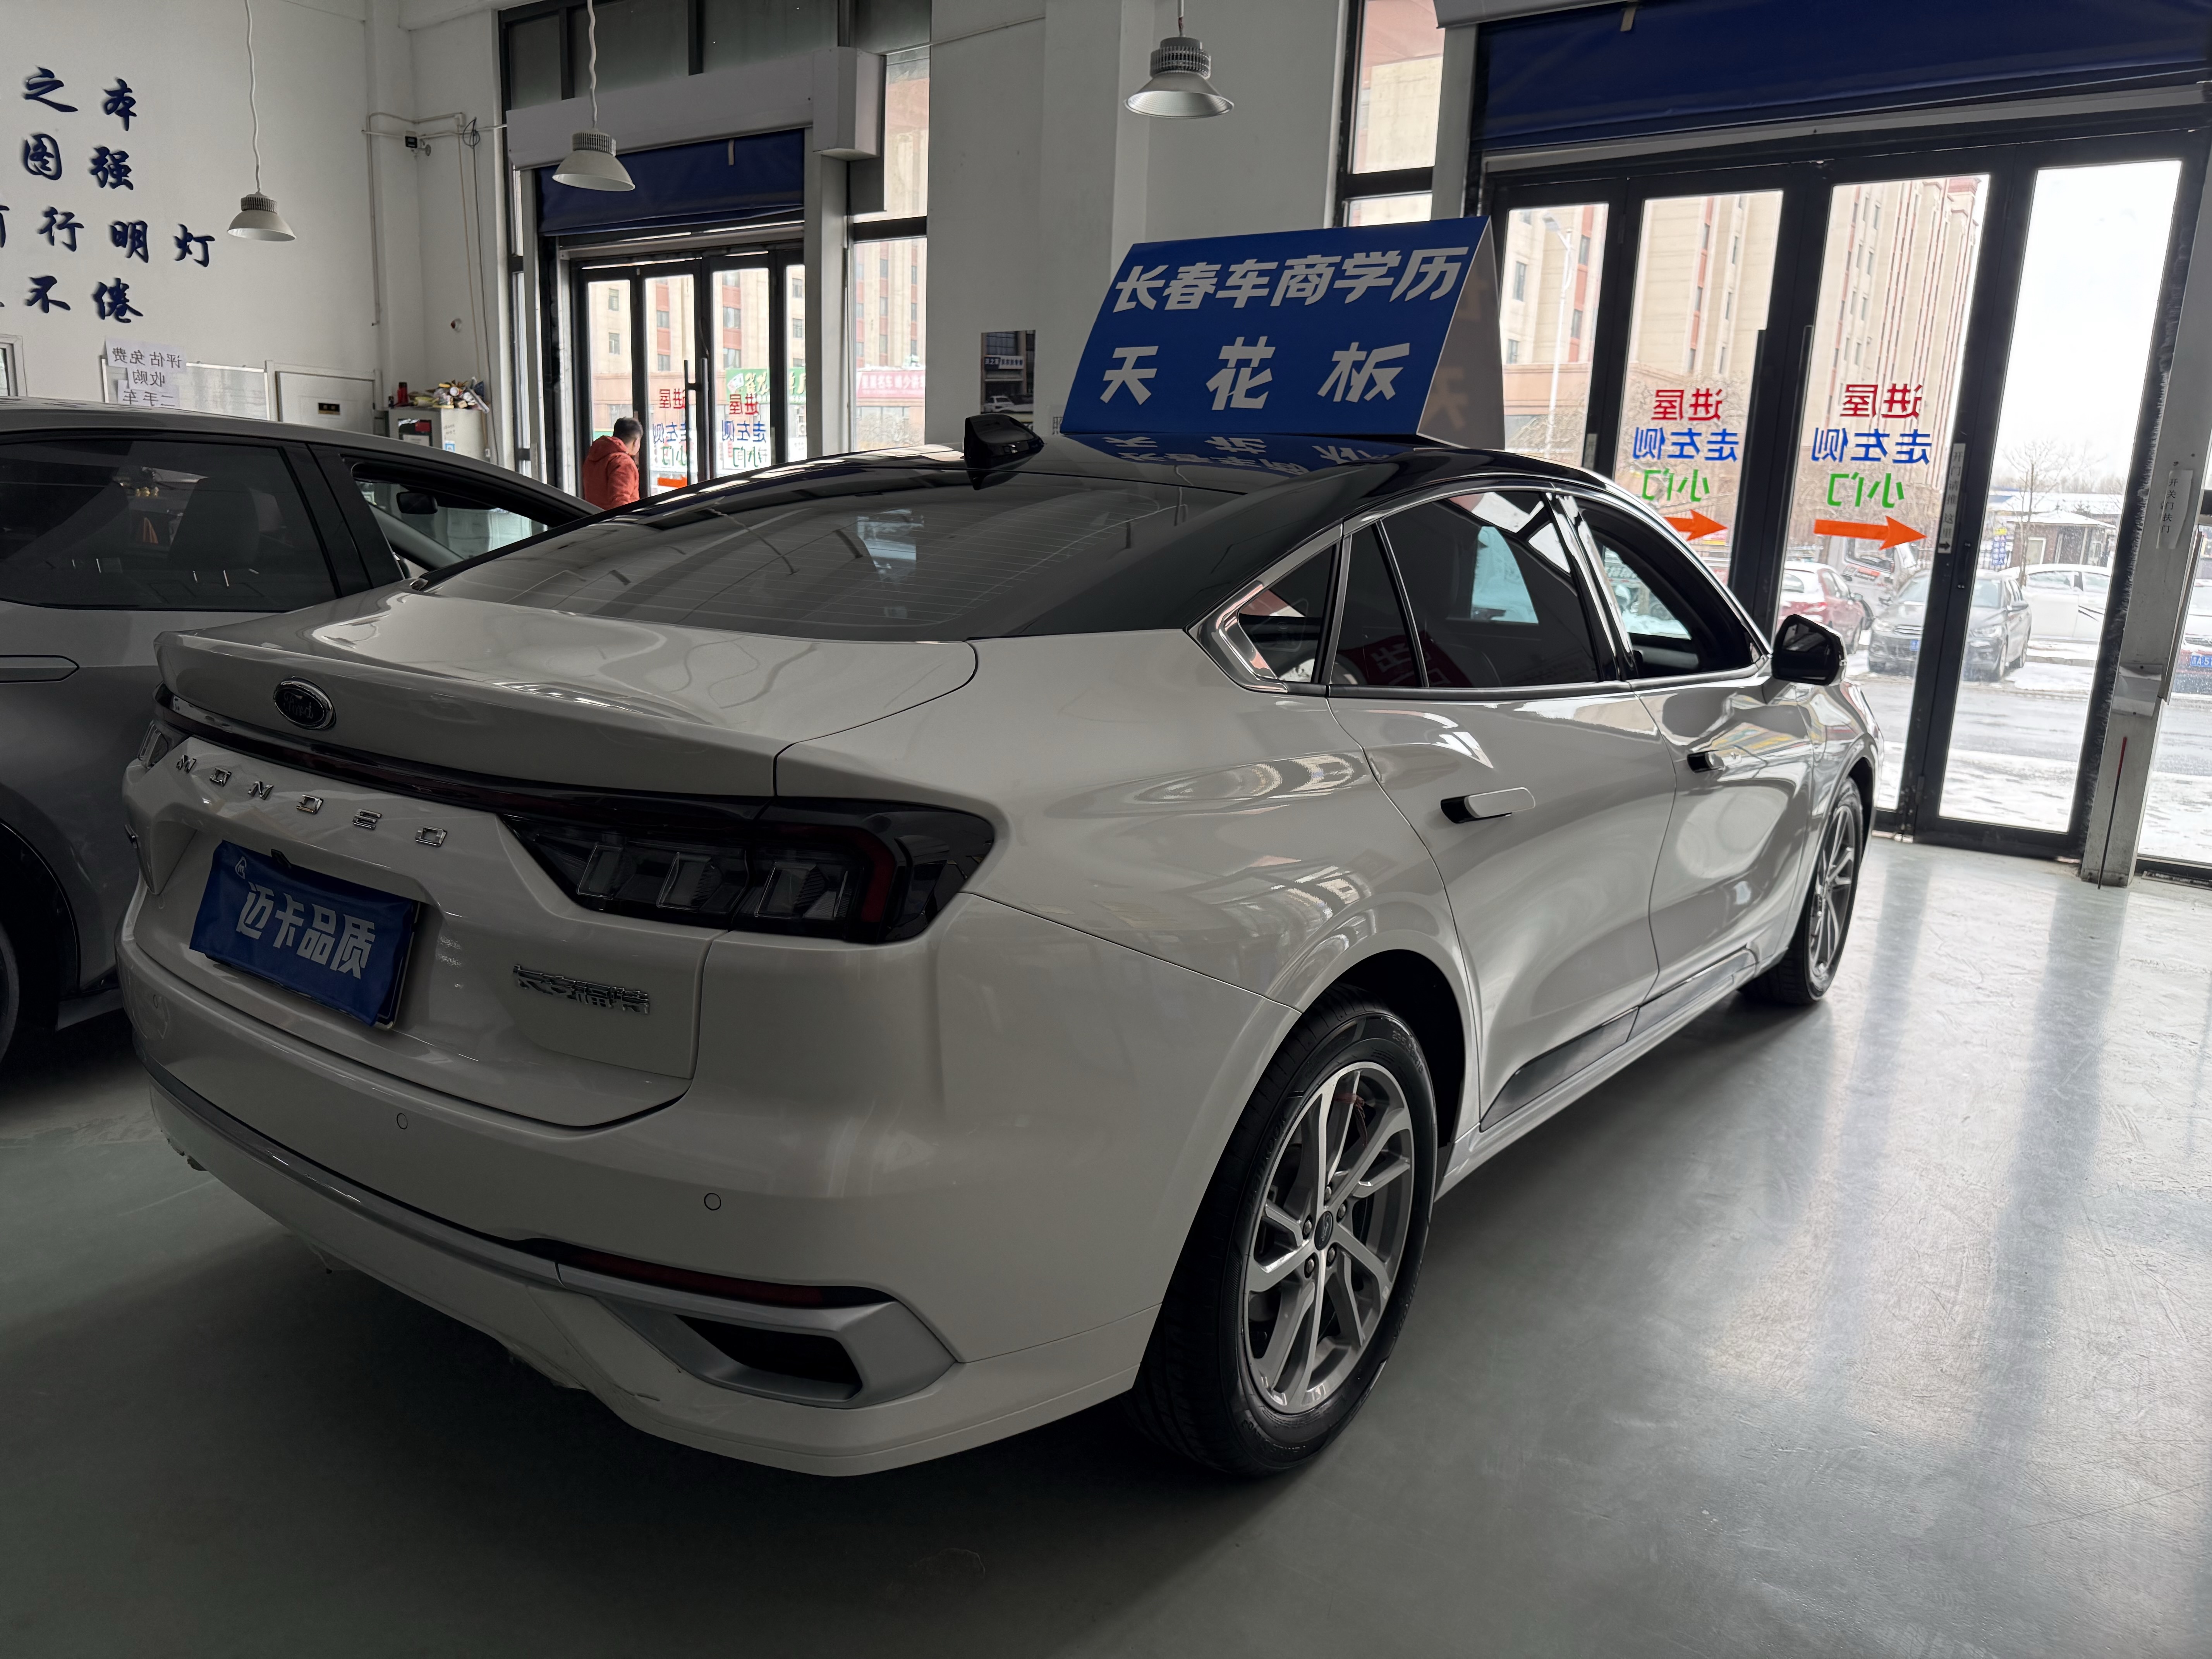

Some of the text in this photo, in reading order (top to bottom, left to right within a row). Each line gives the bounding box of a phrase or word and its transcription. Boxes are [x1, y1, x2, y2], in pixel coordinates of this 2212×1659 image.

[22, 133, 134, 191] 图强
[0, 204, 215, 267] 行明灯
[1113, 246, 1469, 313] 长春车商学历
[1100, 336, 1410, 410] 天花板
[175, 754, 447, 848] MONDEO
[235, 881, 376, 979] 迈卡品质
